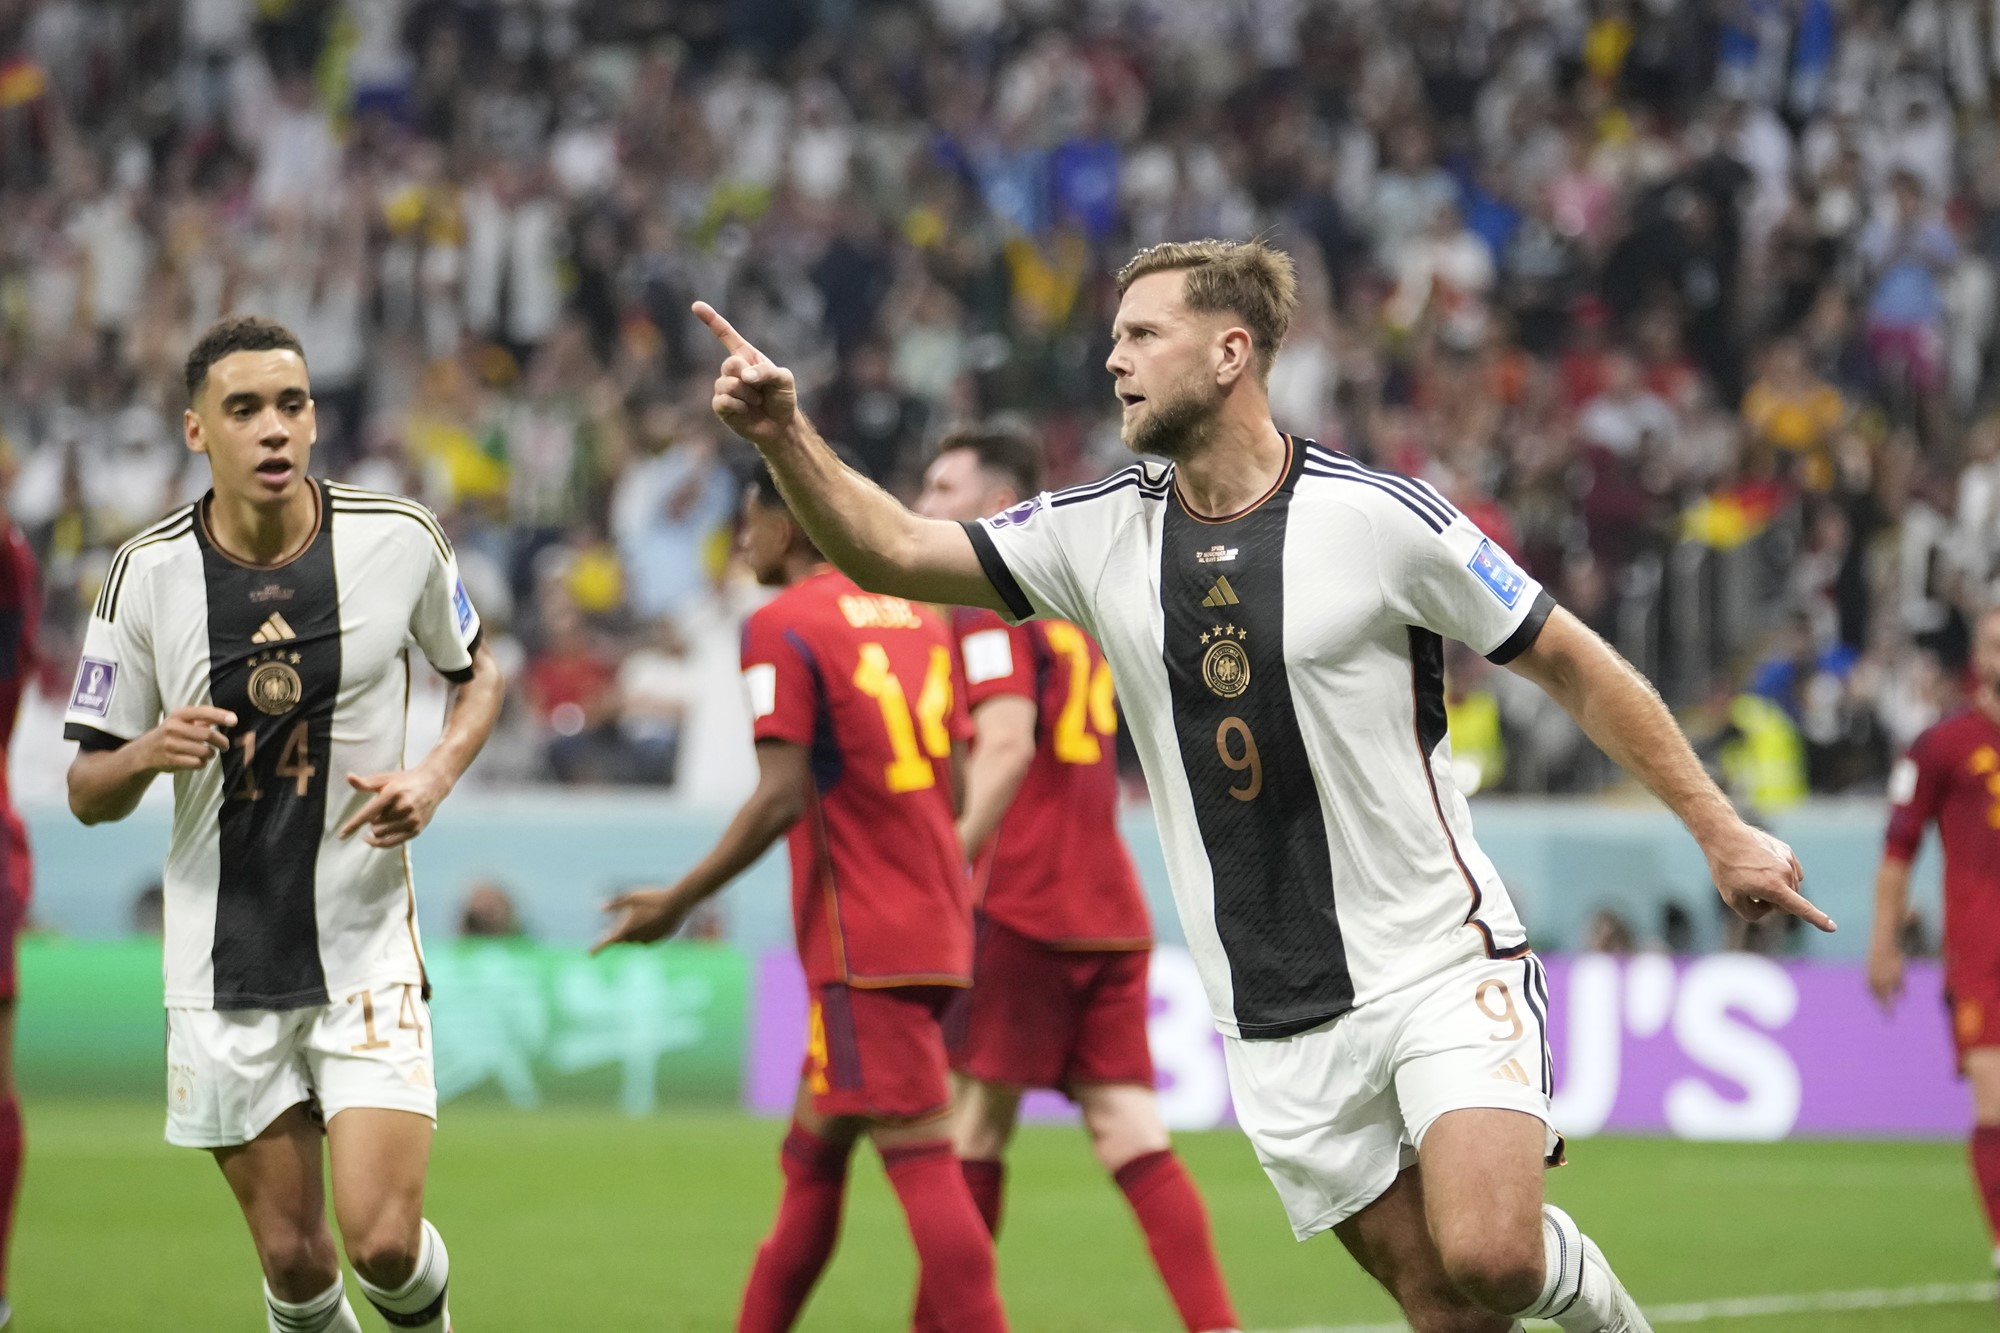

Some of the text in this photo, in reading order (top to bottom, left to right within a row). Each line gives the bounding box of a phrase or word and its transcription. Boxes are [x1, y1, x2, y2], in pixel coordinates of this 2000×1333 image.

[233, 720, 317, 802] 14
[1216, 716, 1262, 802] 9
[347, 983, 424, 1052] 14
[1475, 979, 1523, 1042] 9
